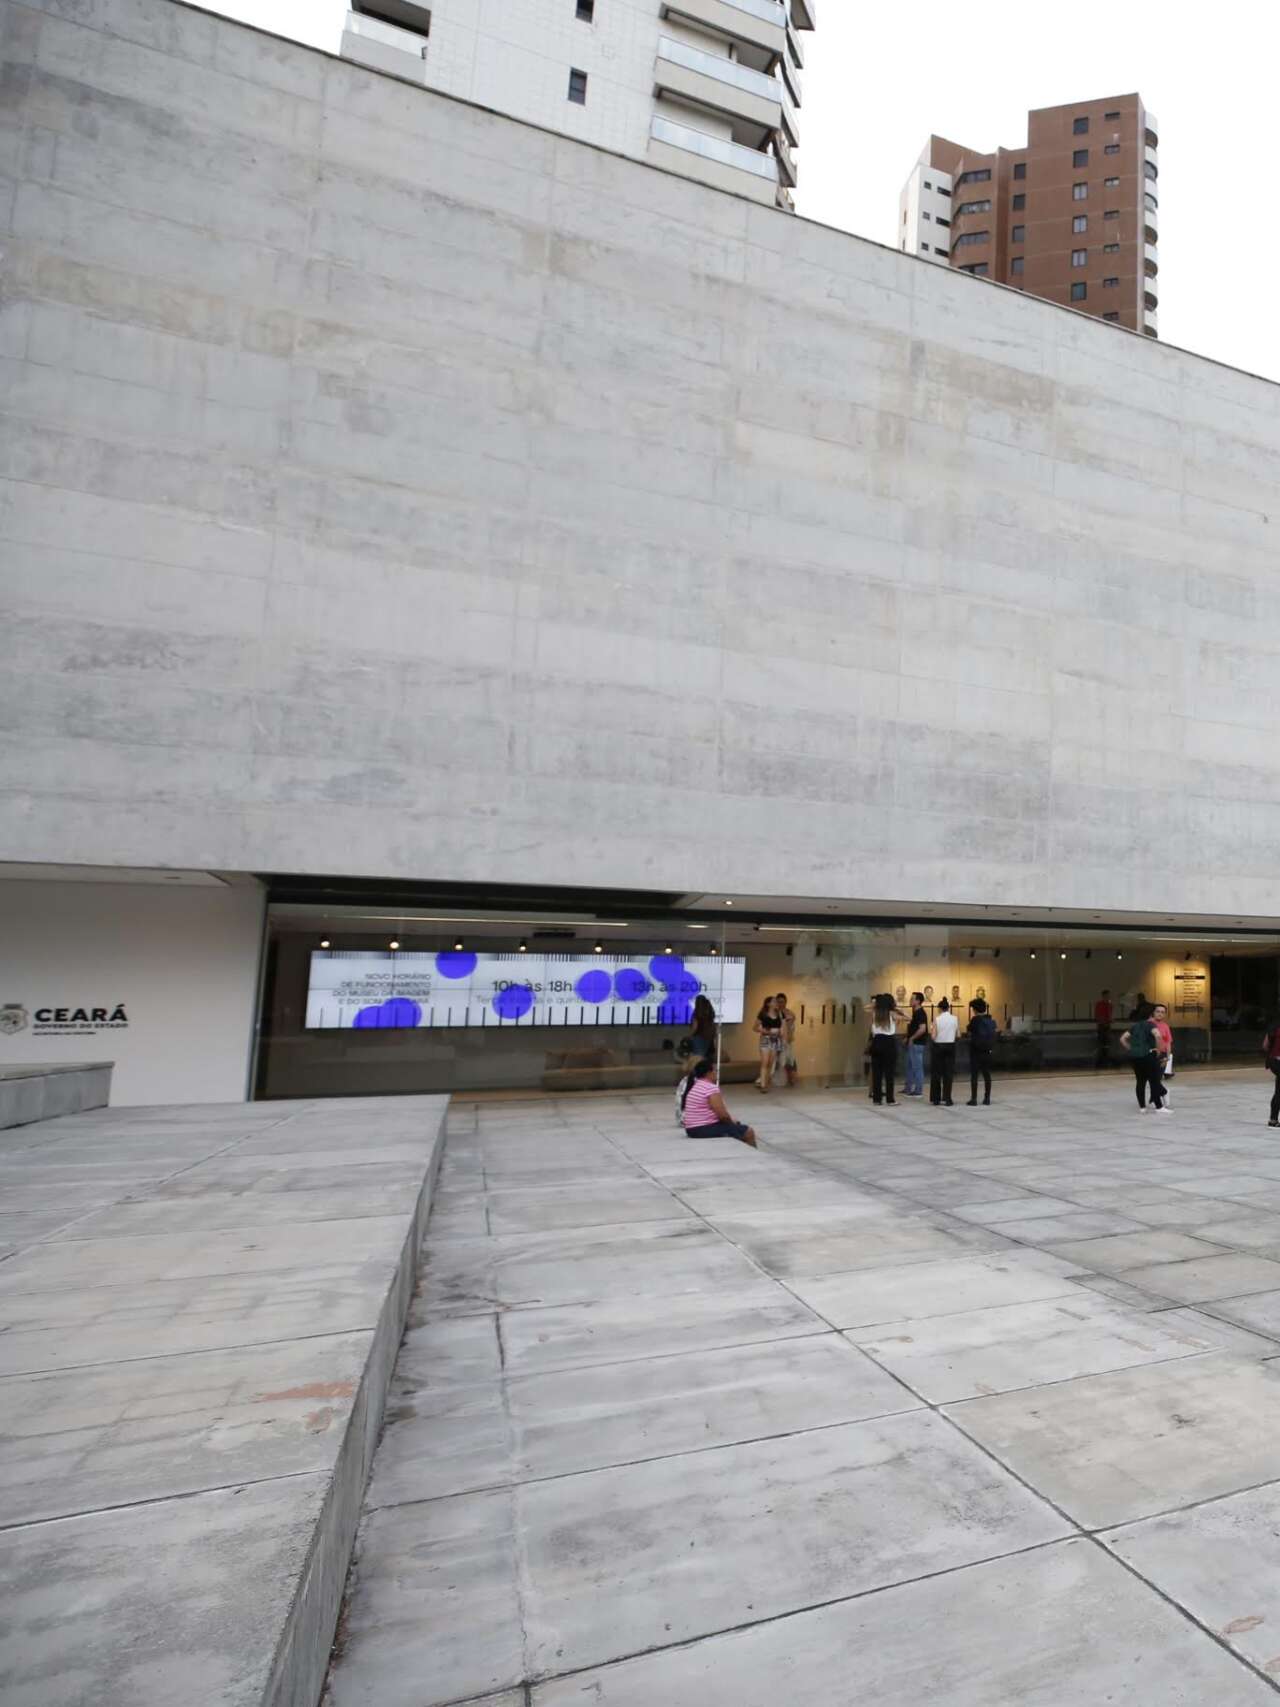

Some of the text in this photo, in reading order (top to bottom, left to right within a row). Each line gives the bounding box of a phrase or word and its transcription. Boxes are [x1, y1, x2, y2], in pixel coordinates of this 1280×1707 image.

[492, 980, 518, 992] 10h
[548, 980, 573, 992] 18h
[34, 1003, 128, 1022] CEARÁ
